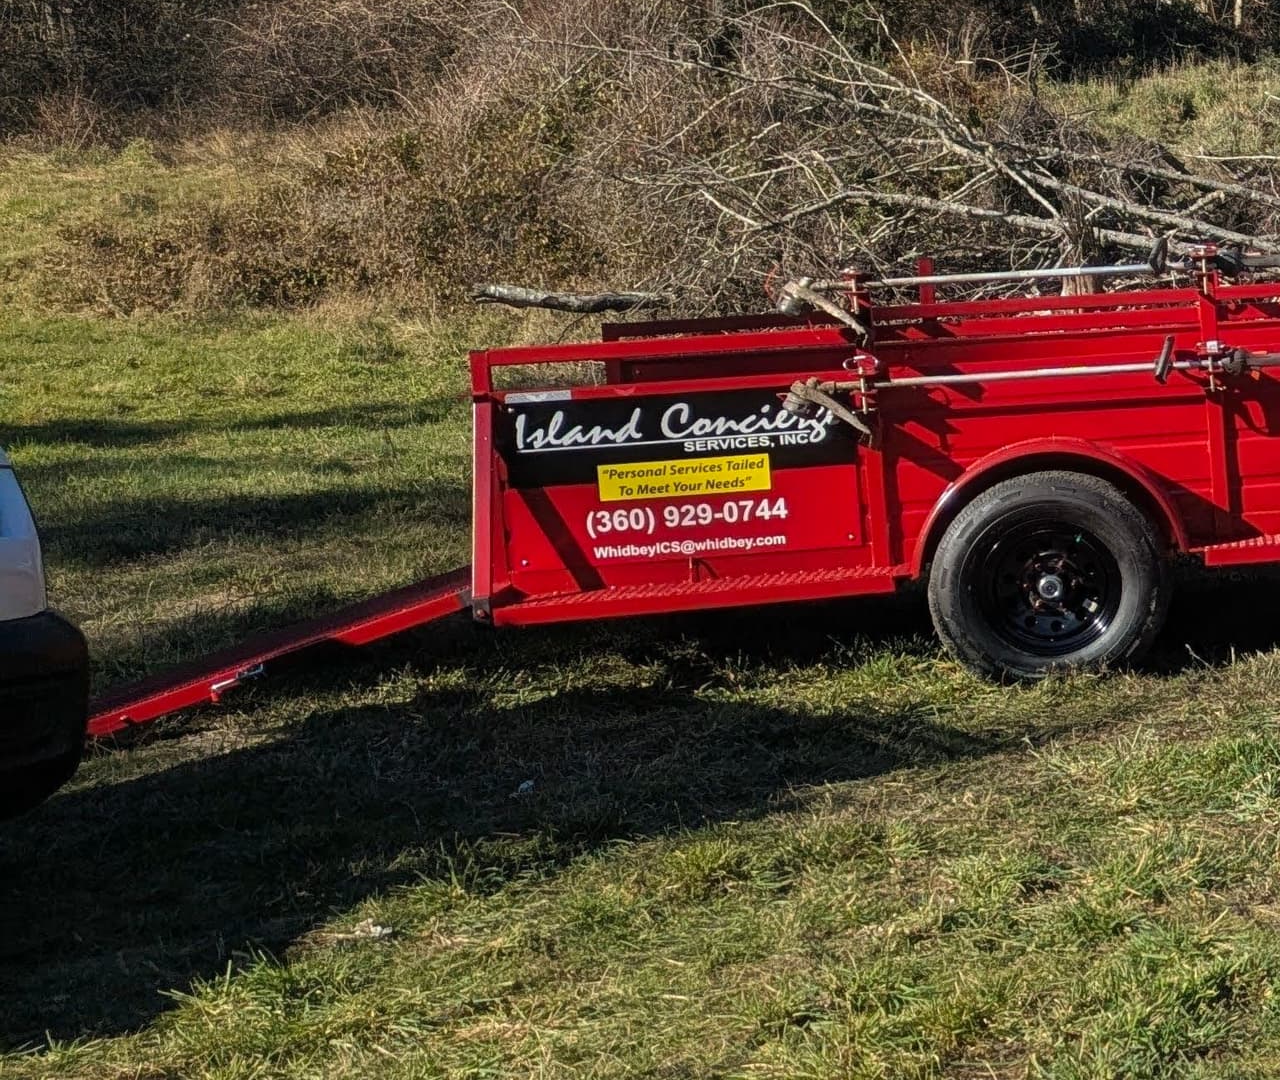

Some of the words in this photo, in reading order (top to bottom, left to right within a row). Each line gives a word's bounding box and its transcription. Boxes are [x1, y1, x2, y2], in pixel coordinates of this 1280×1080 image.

[515, 407, 642, 449] Island
[661, 402, 835, 443] Concierg
[683, 434, 774, 453] SERVICES,
[670, 462, 723, 476] Services
[726, 458, 765, 472] Tailed
[619, 485, 634, 497] To
[637, 483, 670, 496] Meet
[673, 481, 701, 493] Your
[586, 506, 655, 538] (360)
[664, 497, 789, 528] 929-0744
[593, 532, 787, 560] WhidbeyICS@whidbey.com
